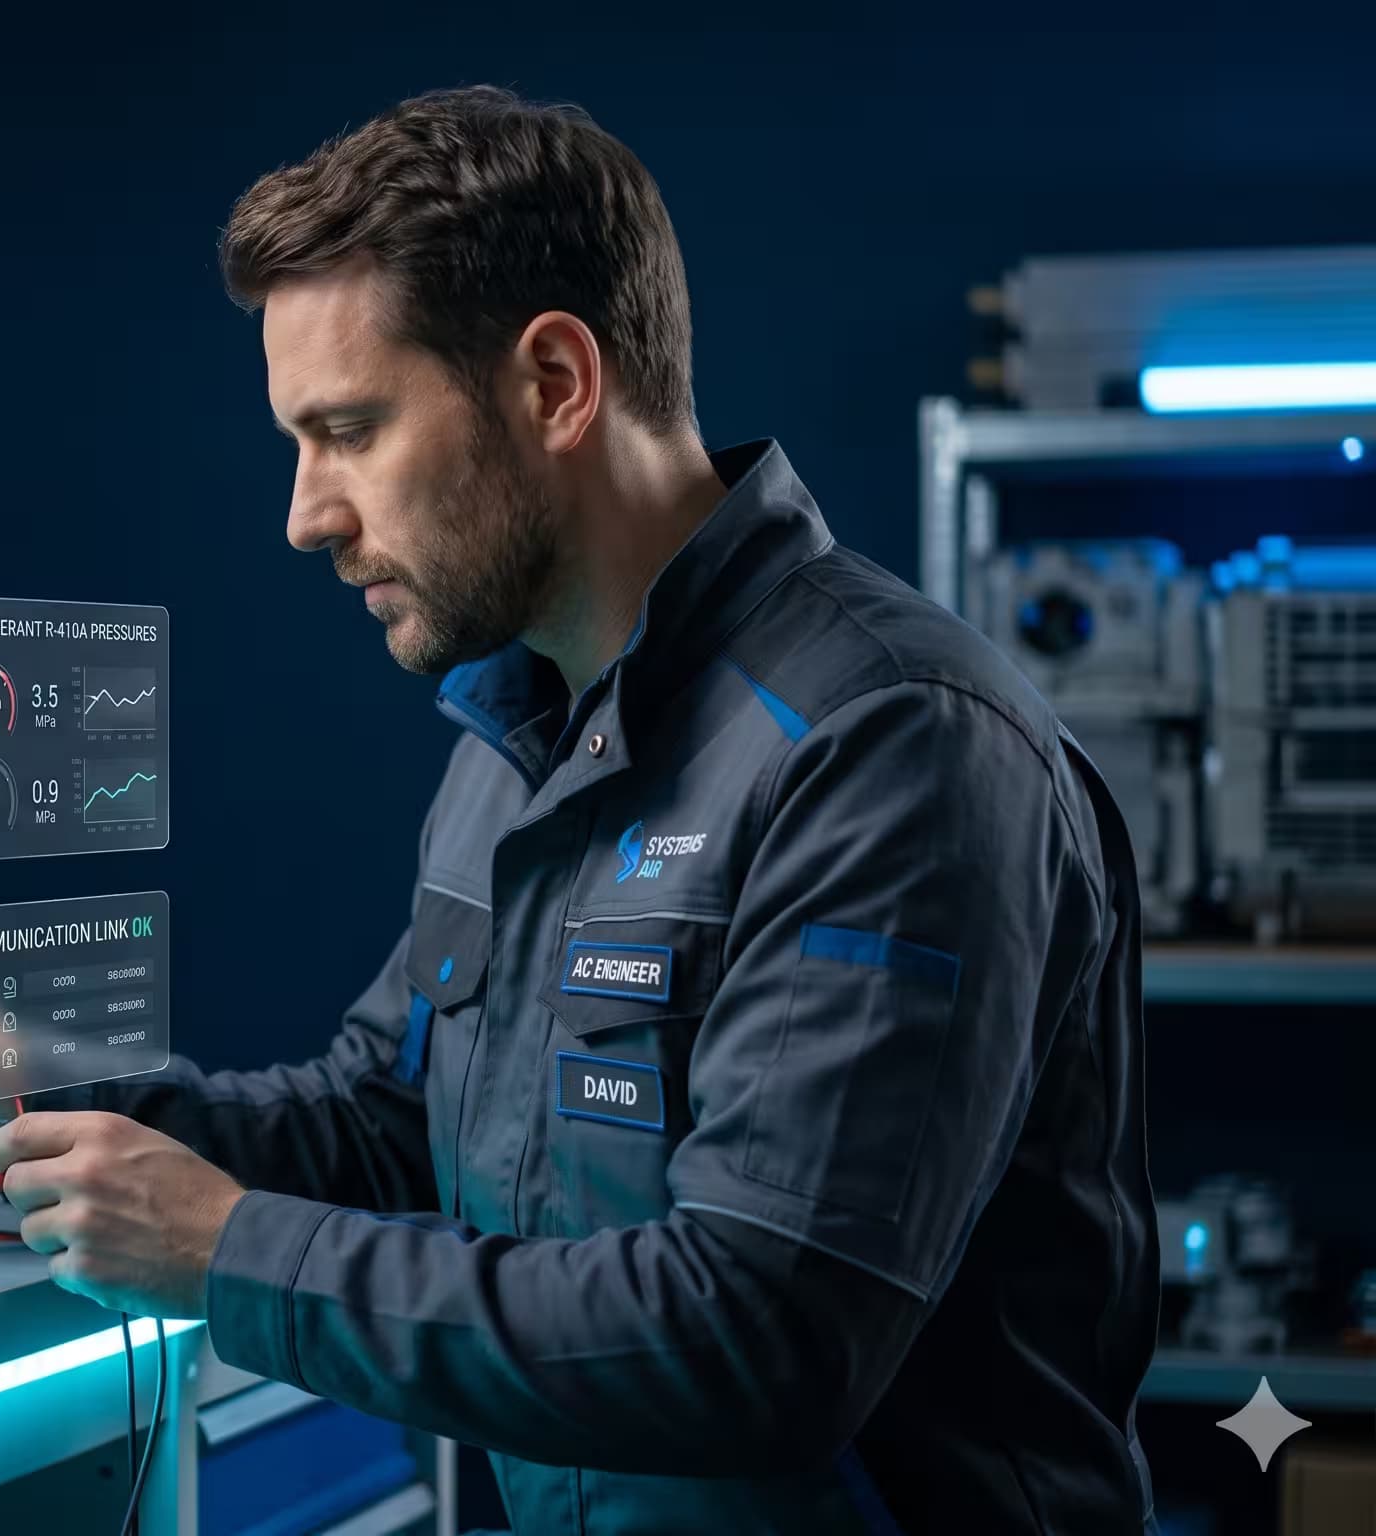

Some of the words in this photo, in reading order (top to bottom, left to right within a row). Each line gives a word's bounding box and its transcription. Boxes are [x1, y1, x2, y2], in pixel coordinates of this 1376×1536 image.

[45, 621, 88, 639] R-410A
[91, 623, 157, 642] PRESSURES
[31, 684, 58, 708] 3.5
[35, 714, 56, 728] MPa
[32, 779, 58, 803] 0.9
[35, 810, 56, 824] MPa
[636, 859, 663, 878] AIR
[95, 918, 129, 942] LINK
[132, 916, 153, 937] OK
[572, 957, 592, 978] AC
[593, 958, 661, 985] ENGINEER
[584, 1075, 637, 1105] DAVID
